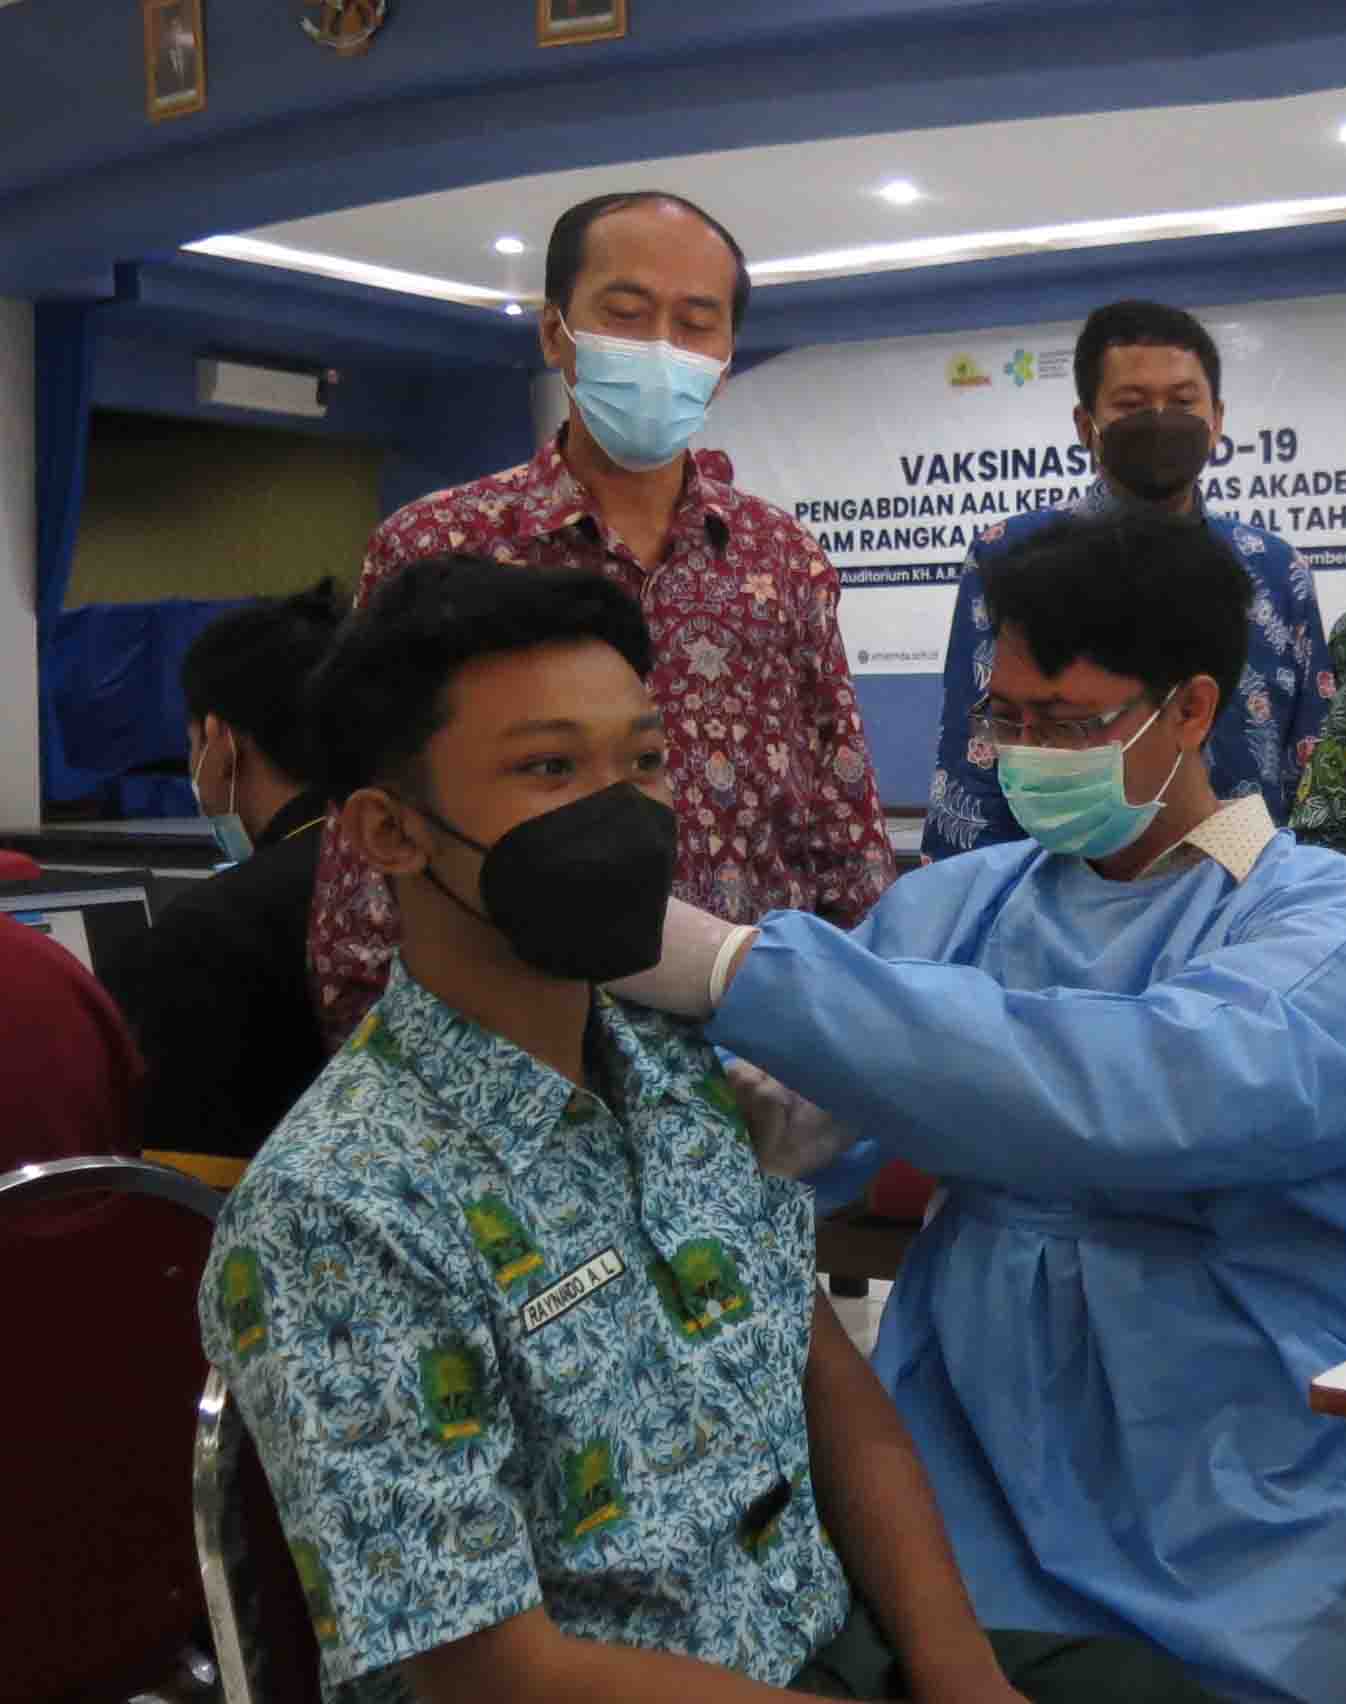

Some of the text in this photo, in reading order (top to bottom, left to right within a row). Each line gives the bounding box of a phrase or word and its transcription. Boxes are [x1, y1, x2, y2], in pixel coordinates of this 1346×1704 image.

[901, 444, 1097, 486] VAKSINASI
[795, 494, 954, 523] PENGABDIAN
[960, 491, 1009, 516] AAL
[860, 525, 966, 552] RANGKA
[840, 568, 910, 584] Auditorium
